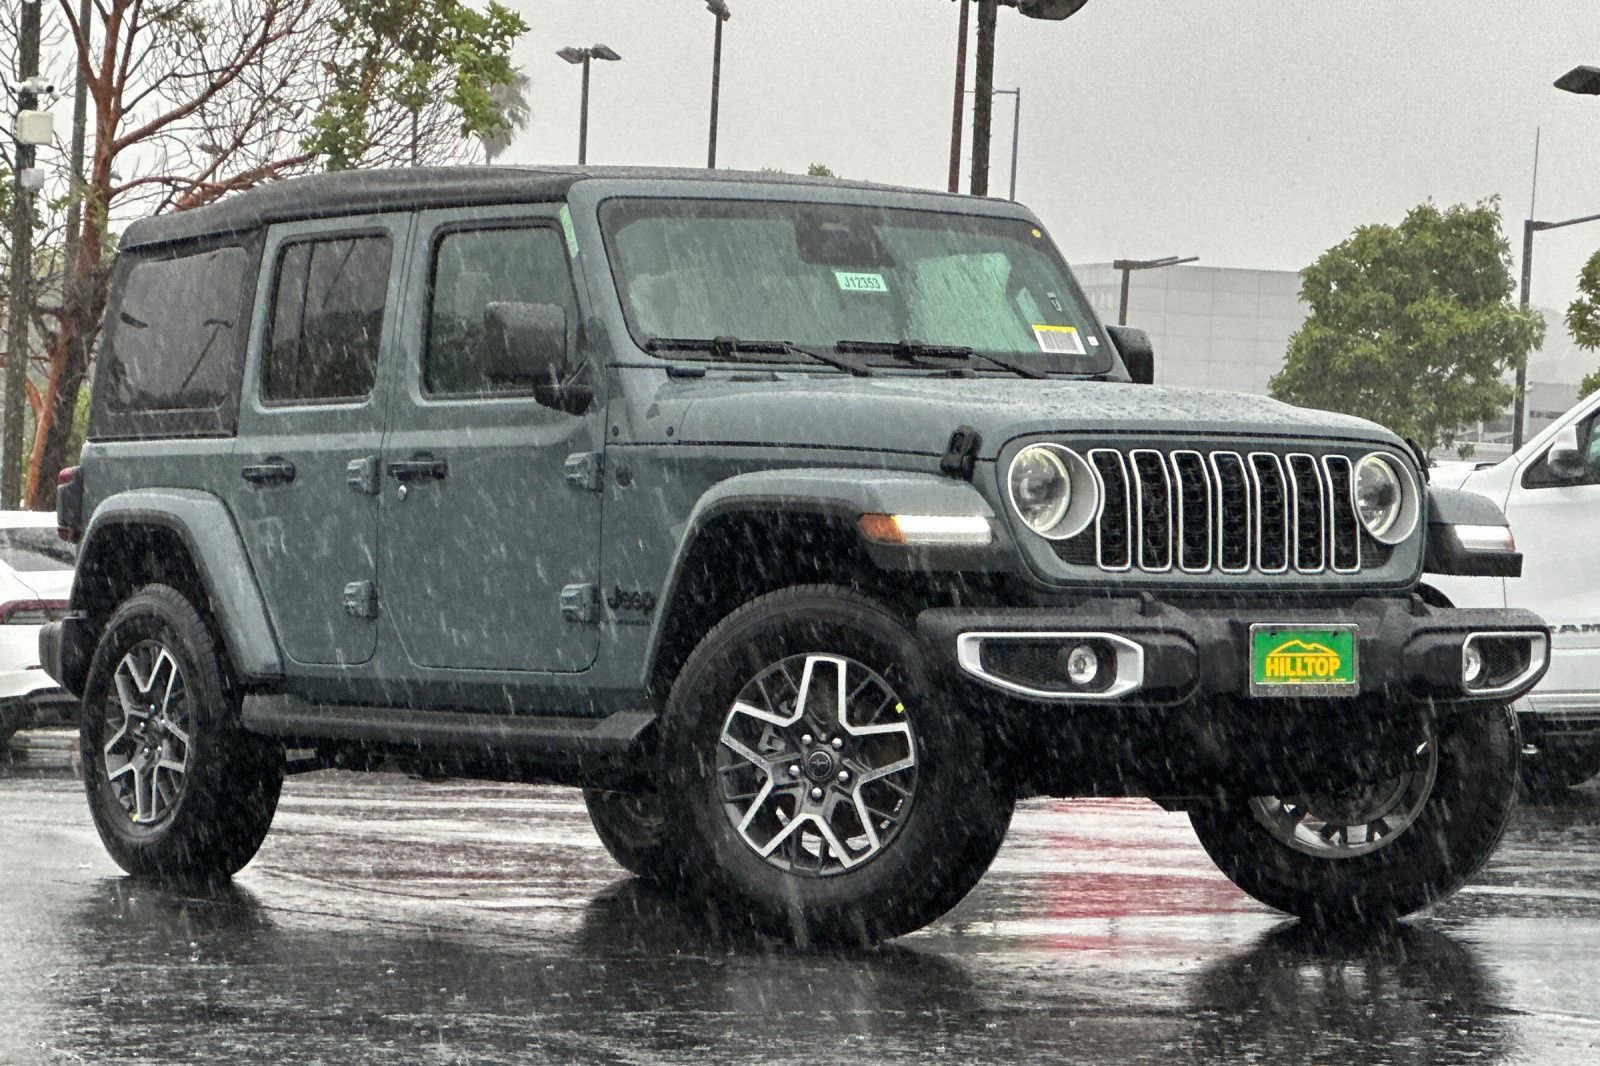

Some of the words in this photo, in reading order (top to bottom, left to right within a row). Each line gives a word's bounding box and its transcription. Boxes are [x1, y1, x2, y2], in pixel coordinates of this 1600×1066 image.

[844, 276, 881, 289] J12353
[607, 585, 656, 615] Jeep
[1265, 657, 1341, 677] HILLTOP
